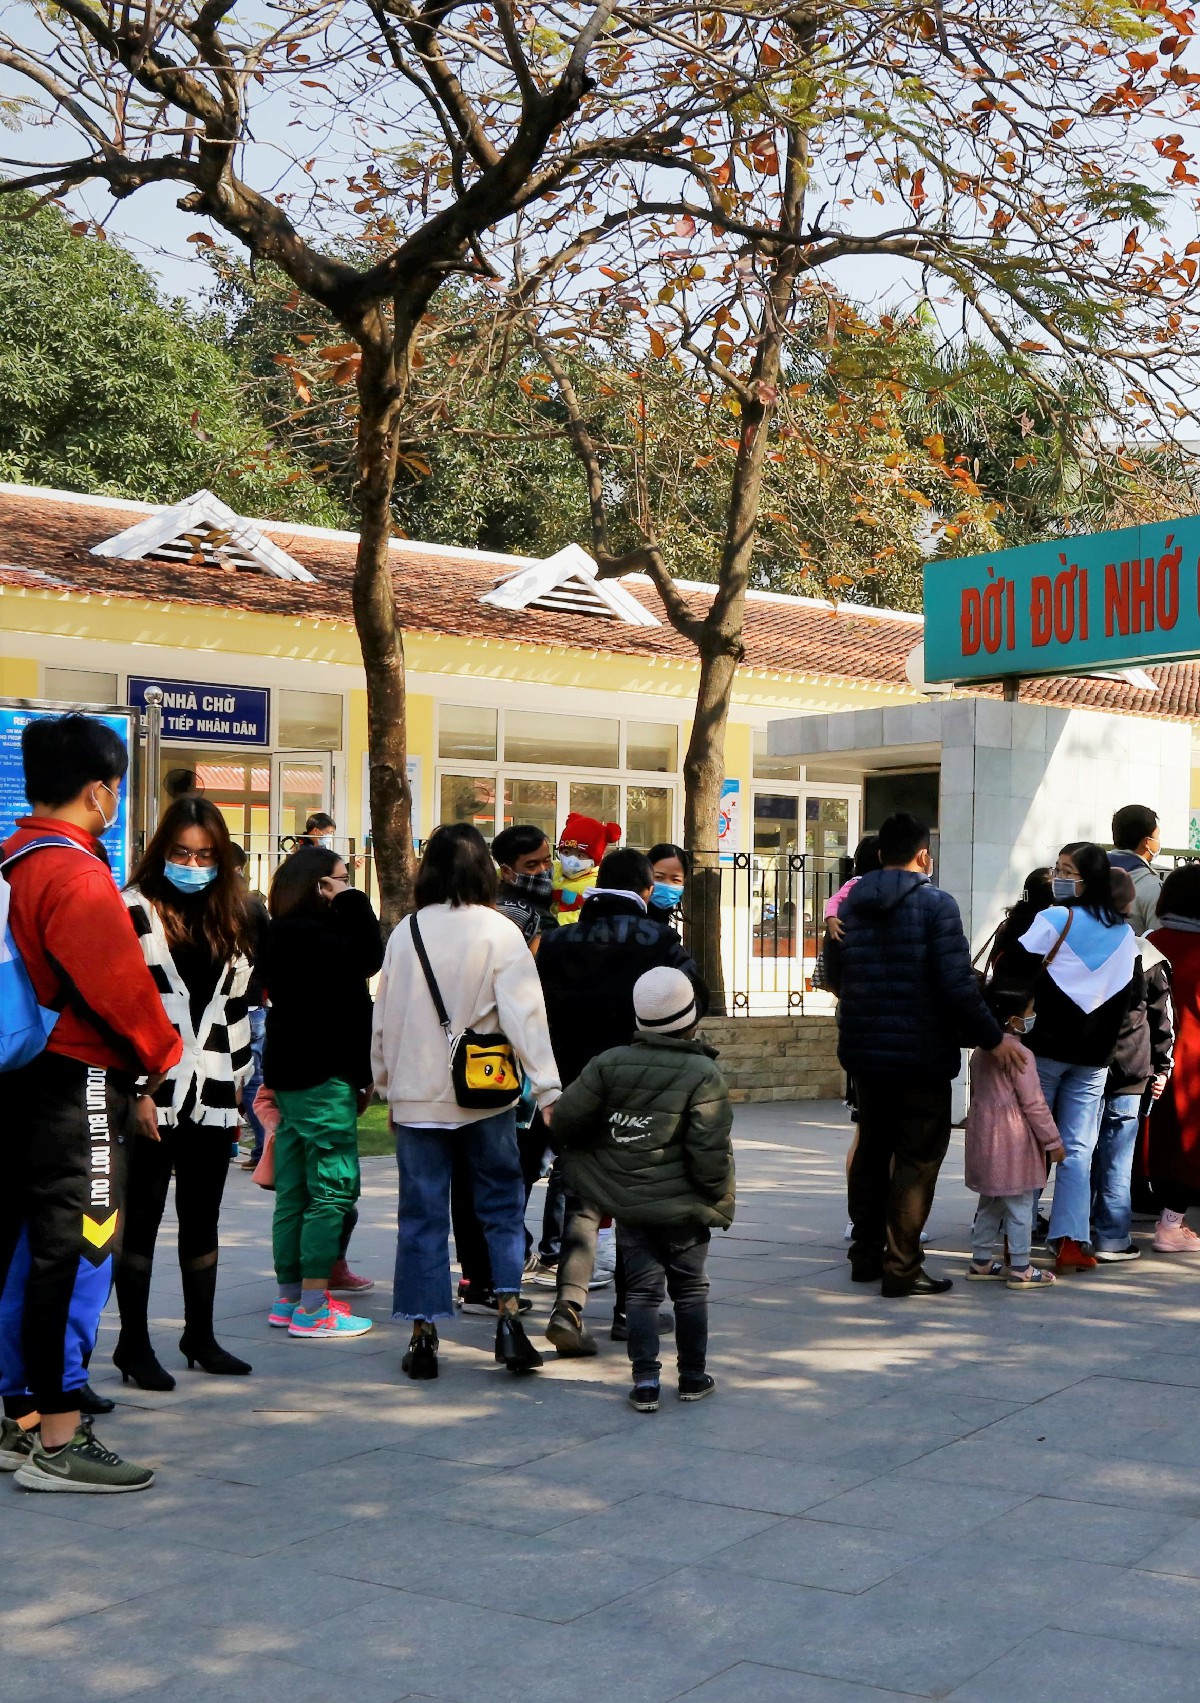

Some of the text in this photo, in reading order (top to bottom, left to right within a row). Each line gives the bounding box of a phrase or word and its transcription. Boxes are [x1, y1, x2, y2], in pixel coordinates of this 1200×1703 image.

[960, 566, 1016, 656] ĐỜI
[1030, 553, 1089, 647] ĐỜI
[1104, 534, 1183, 637] NHỚ
[163, 691, 236, 713] NHÀ CHỜ
[168, 713, 194, 731] TIẾP
[197, 718, 230, 734] NHÂN
[233, 720, 257, 736] DÂN
[608, 1112, 653, 1128] NIKE
[86, 1067, 111, 1207] DOWN BUT NOT OUT
